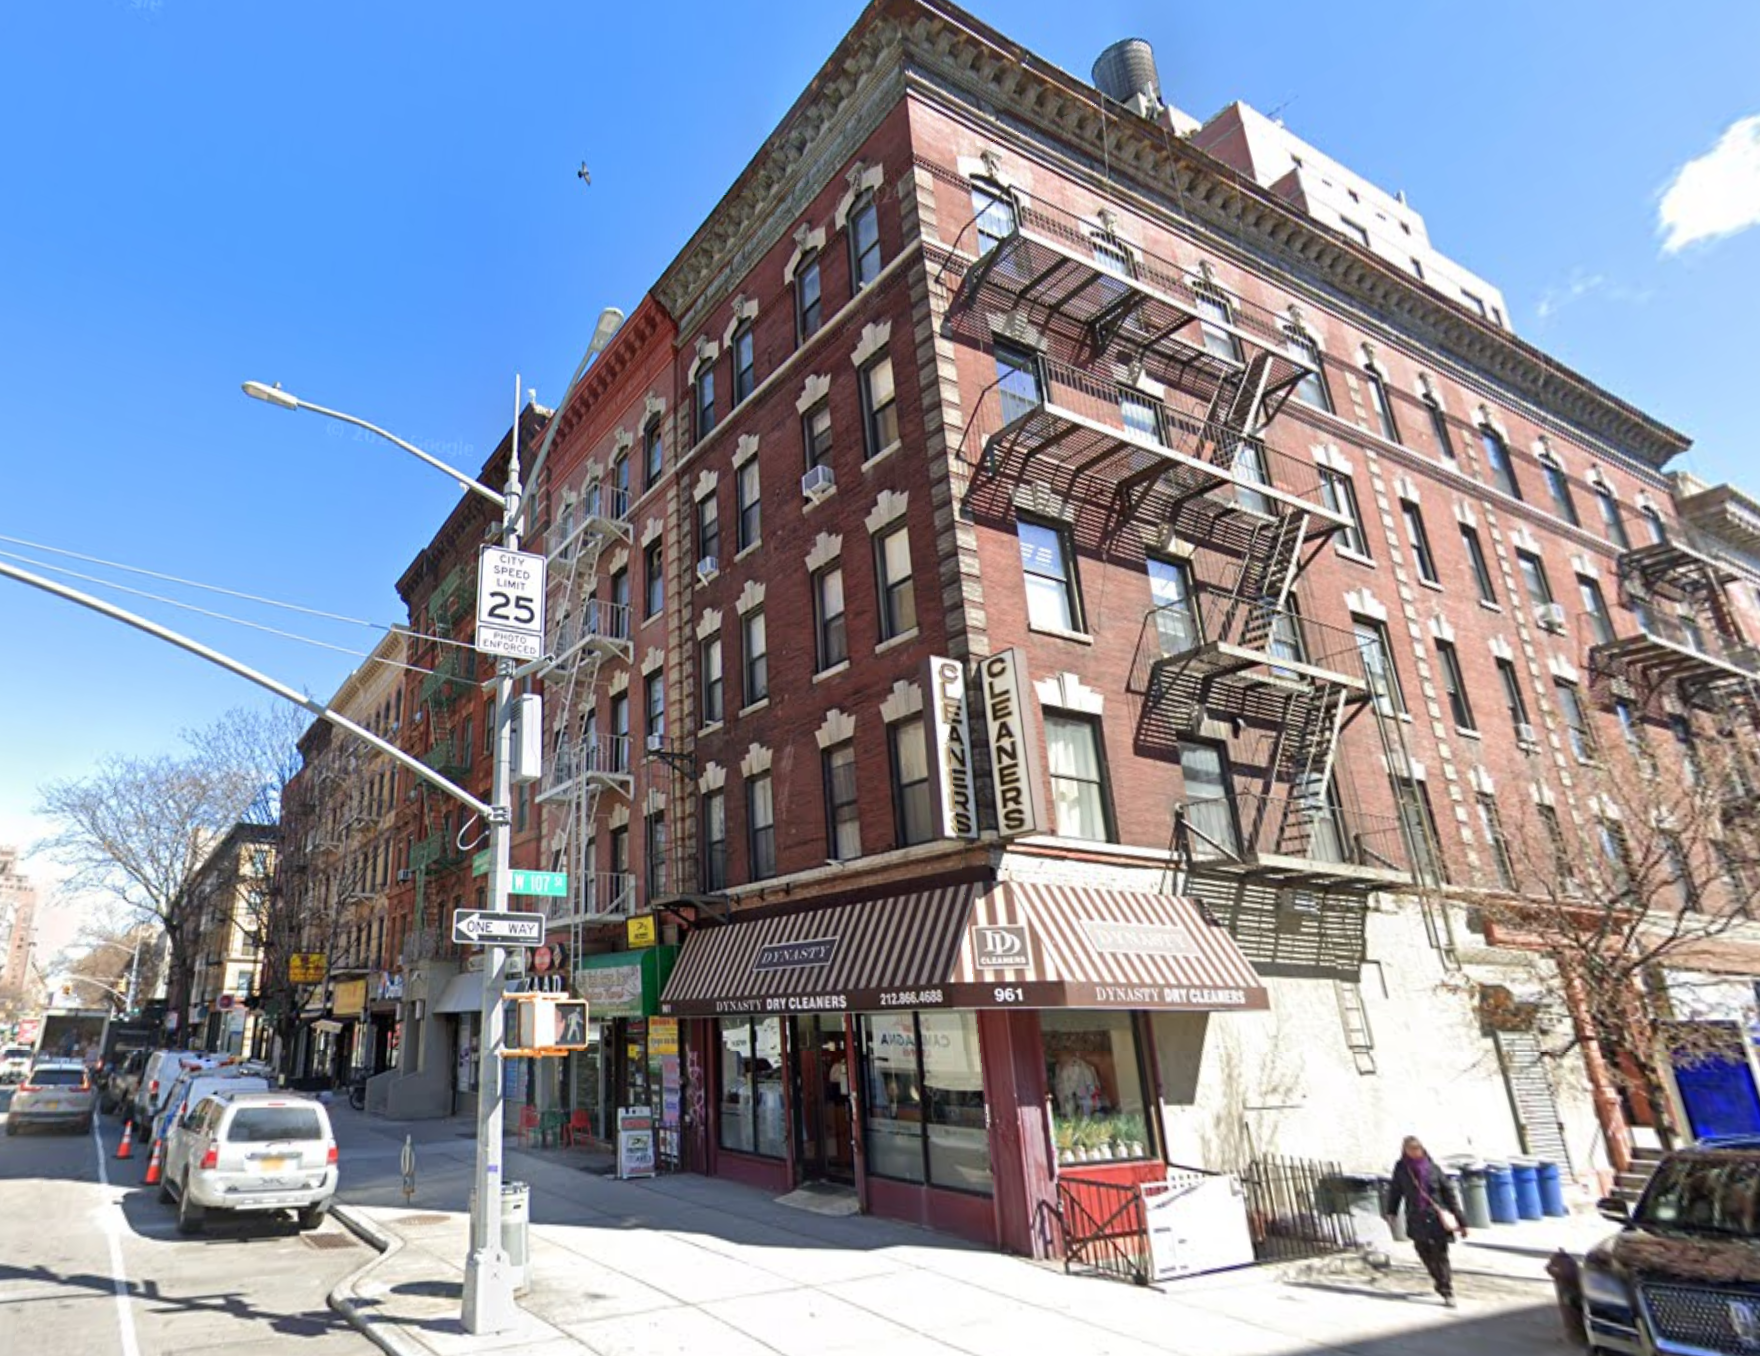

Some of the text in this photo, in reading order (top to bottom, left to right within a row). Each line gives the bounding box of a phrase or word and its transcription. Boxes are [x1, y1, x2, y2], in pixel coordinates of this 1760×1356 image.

[500, 554, 525, 566] CITY
[493, 564, 530, 580] SPEED
[497, 577, 526, 590] LIMIT
[487, 590, 535, 624] 25
[483, 638, 537, 655] ENFORCED
[493, 631, 527, 645] PHOTO
[938, 662, 972, 834] CLEANERS
[986, 656, 1025, 831] CLEANERS
[513, 873, 525, 890] W
[531, 874, 550, 893] 107
[467, 921, 536, 935] ONE WAY
[1096, 928, 1187, 949] DYNASTY
[761, 945, 830, 964] DYNASTY
[980, 955, 1027, 965] CLEANERS
[993, 987, 1024, 1002] 961
[1095, 986, 1246, 1004] DYNASTY DRY CLEANERS
[716, 995, 847, 1012] DYNASTY DRY CLEANERS
